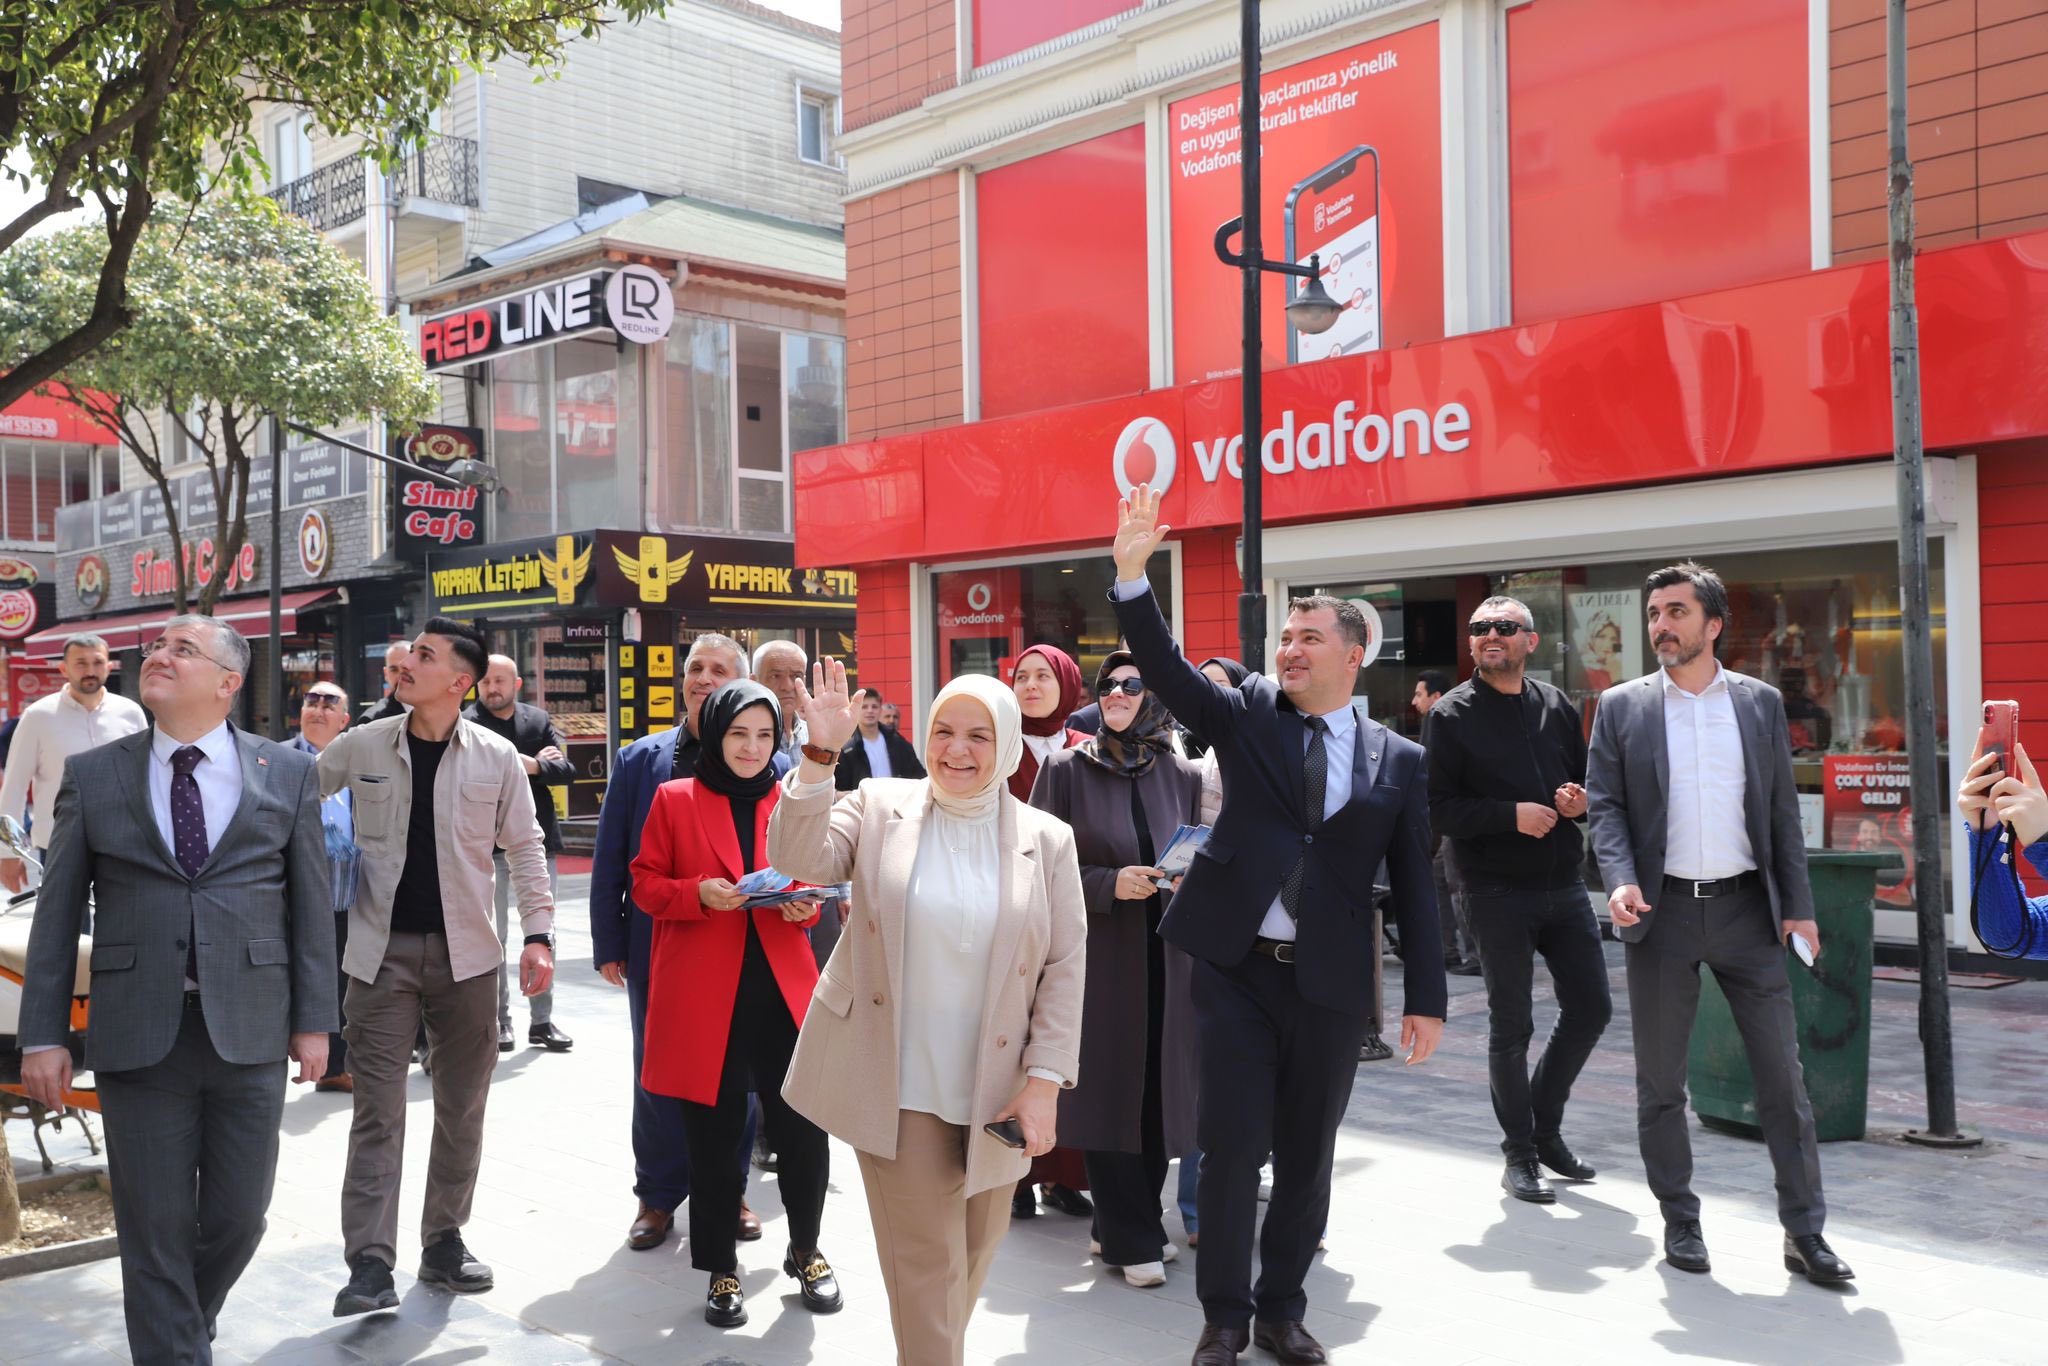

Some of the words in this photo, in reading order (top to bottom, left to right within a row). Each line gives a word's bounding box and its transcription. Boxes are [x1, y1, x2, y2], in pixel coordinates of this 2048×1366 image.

[1180, 103, 1234, 131] Değişen
[1237, 72, 1337, 114] iyaçlarınıza
[1340, 50, 1398, 87] yönelik
[1180, 138, 1198, 155] en
[1259, 106, 1297, 132] turalı
[1299, 90, 1358, 120] teklifler
[1325, 193, 1355, 215] Vodafone
[420, 307, 492, 362] RED
[501, 277, 591, 345] LINE
[621, 322, 660, 336] REDLINE
[402, 481, 478, 510] Simit
[405, 510, 475, 544] Cafe
[196, 538, 255, 591] Ce
[432, 566, 483, 597] YAPRAK
[485, 554, 541, 593] İLETİŞİM
[704, 563, 793, 594] YAPRAK
[566, 626, 603, 637] Infinix
[955, 612, 1005, 625] vodafone
[1834, 763, 1873, 772] Vodafone
[1875, 762, 1887, 772] Ev
[1835, 775, 1863, 790] ÇOK
